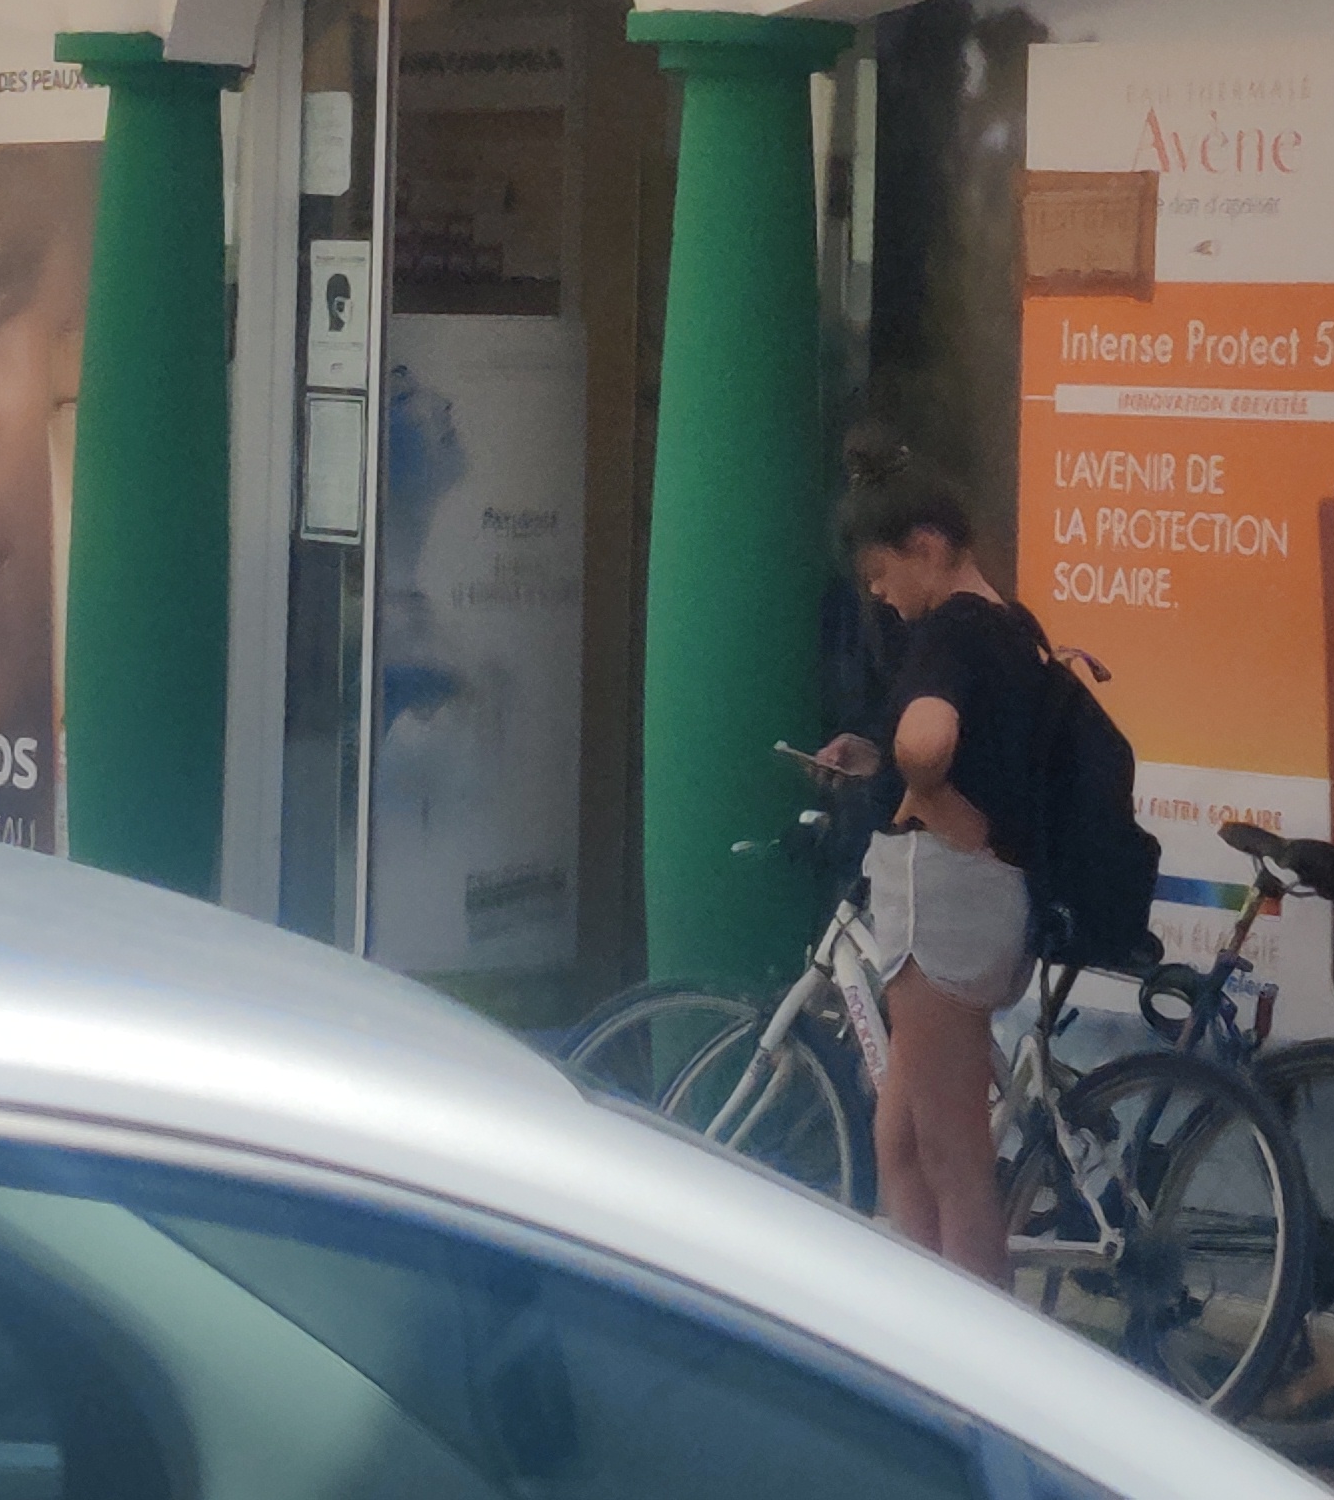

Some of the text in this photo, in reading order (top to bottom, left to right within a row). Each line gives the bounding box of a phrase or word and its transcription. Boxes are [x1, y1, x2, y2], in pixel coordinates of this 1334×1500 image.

[1130, 105, 1304, 175] Avène
[1062, 318, 1174, 364] Intense
[1187, 319, 1301, 367] Protect
[1054, 449, 1226, 495] L'AVENIR DE
[1054, 507, 1290, 560] LA PROTECTION
[1053, 561, 1180, 609] SOLAIRE.
